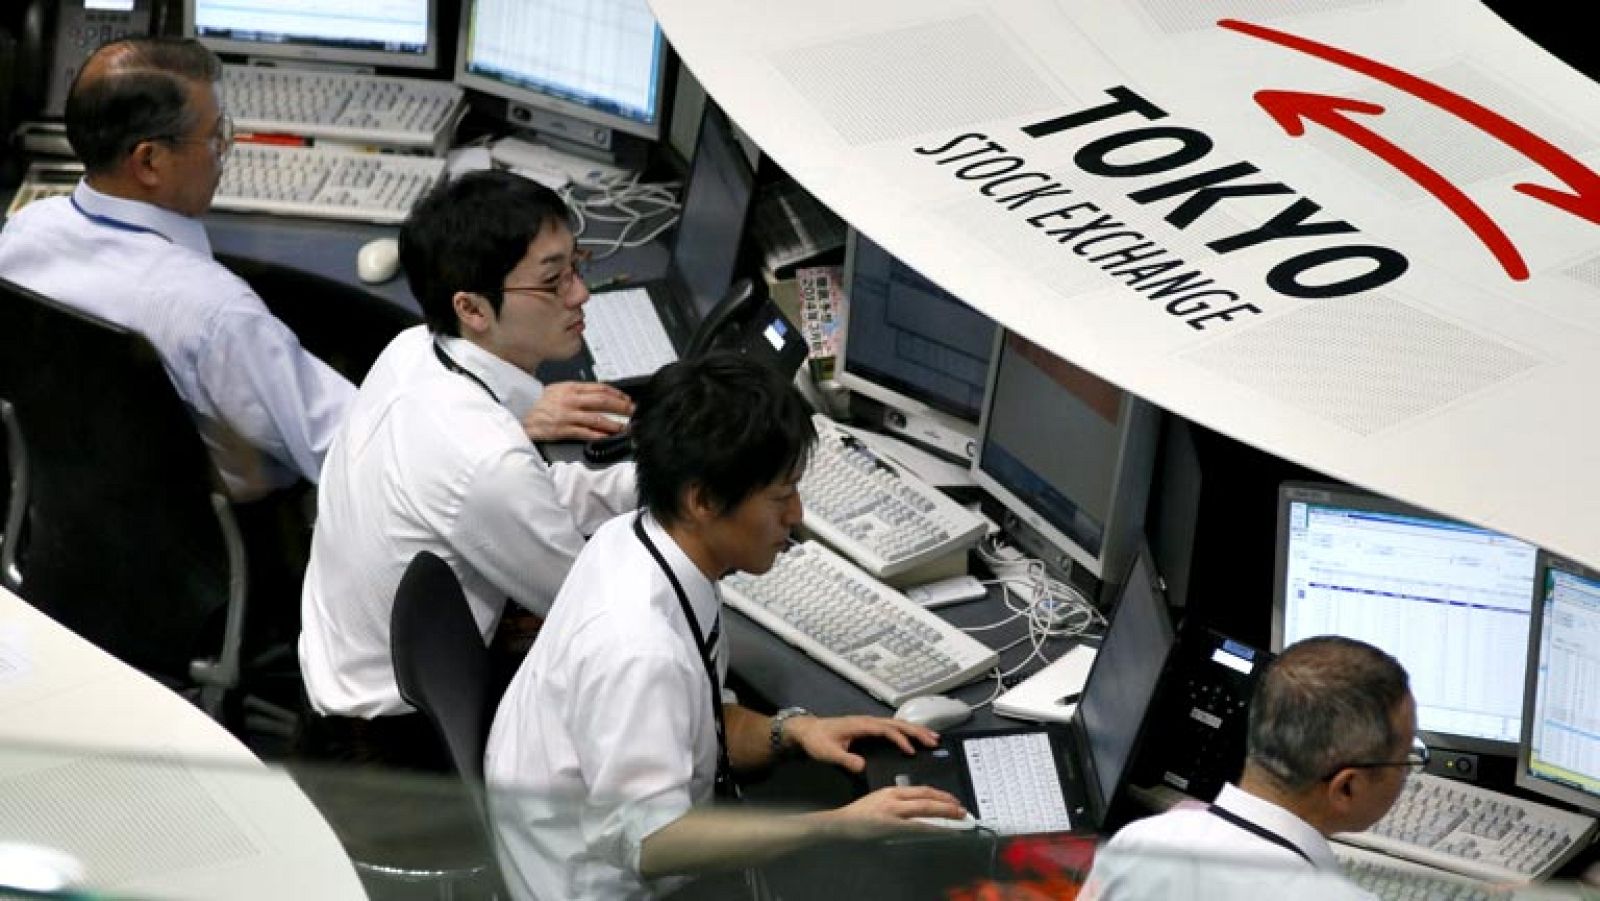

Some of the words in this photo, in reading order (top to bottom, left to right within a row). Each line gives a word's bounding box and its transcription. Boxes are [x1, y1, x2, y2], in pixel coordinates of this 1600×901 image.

[914, 132, 1072, 210] STOCK
[1026, 201, 1263, 331] EXCHANGE
[1020, 85, 1409, 299] TOKYO
